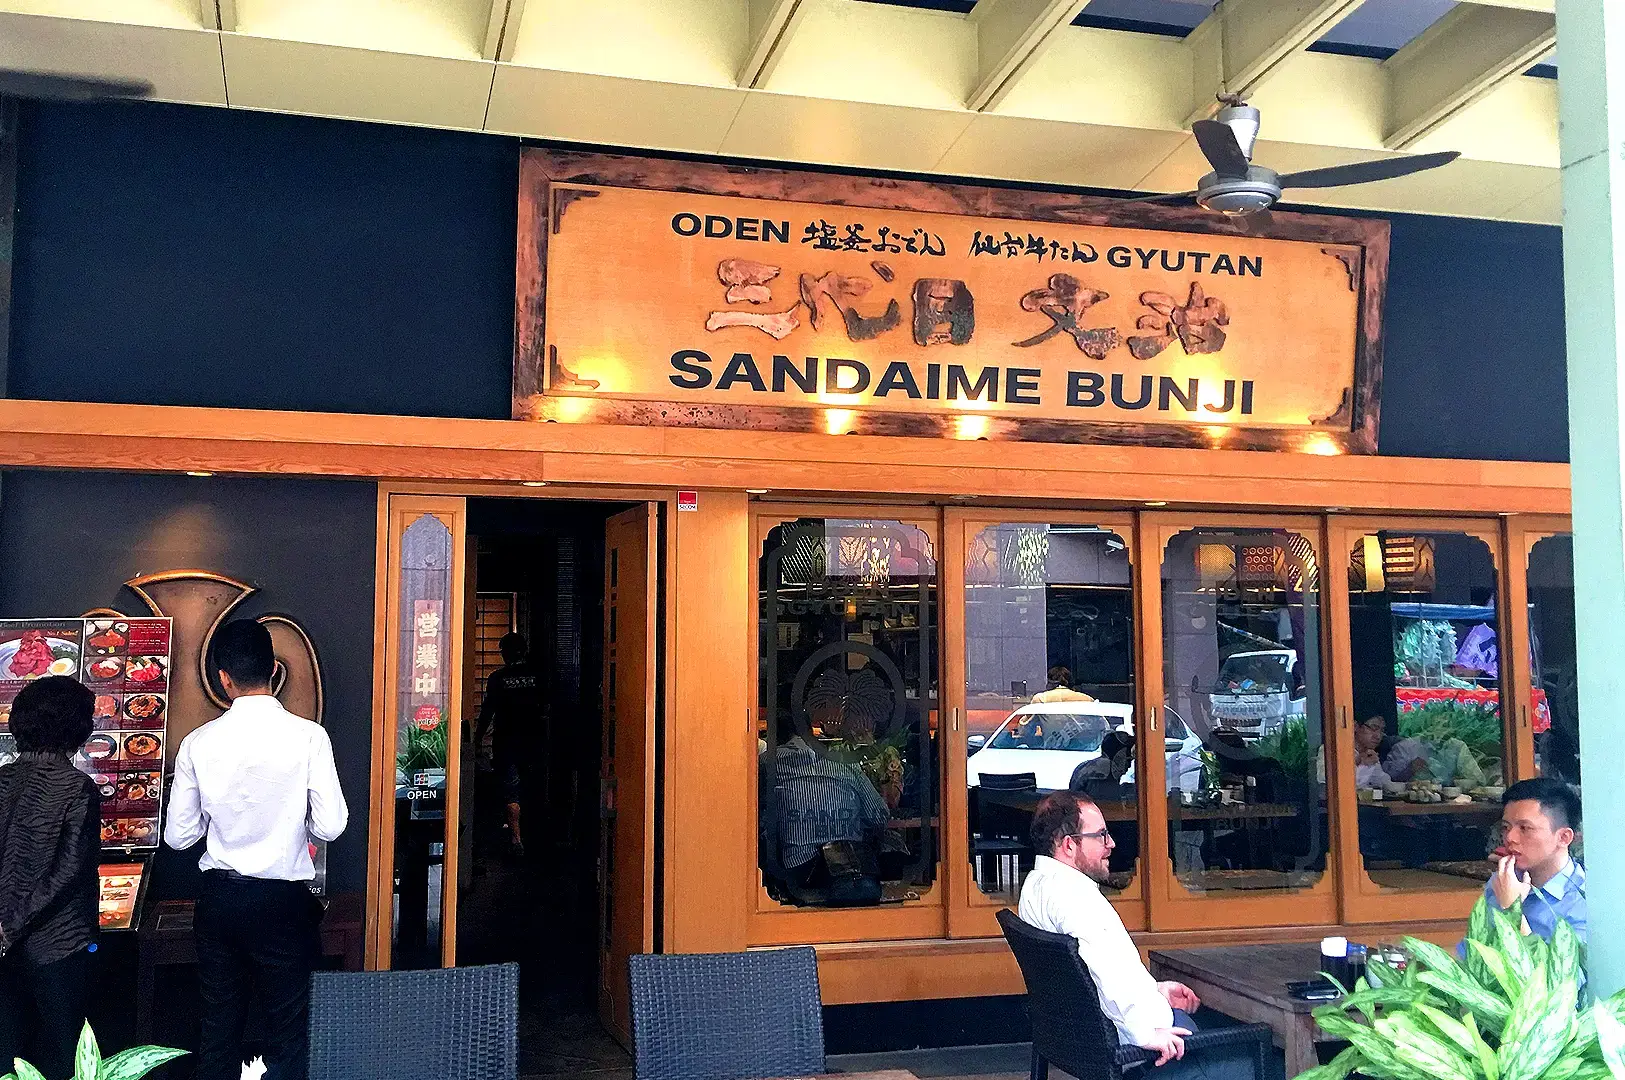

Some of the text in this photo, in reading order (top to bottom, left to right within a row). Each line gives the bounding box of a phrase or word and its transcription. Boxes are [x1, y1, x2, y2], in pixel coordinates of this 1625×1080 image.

[671, 212, 790, 244] ODEN
[800, 219, 947, 257] 塩釜おでん
[1106, 245, 1263, 278] GYUTAN
[705, 257, 976, 347] 三代目
[668, 349, 1255, 415] SANDAIME BUNJI
[416, 612, 440, 698] 営業中
[407, 790, 437, 800] OPEN
